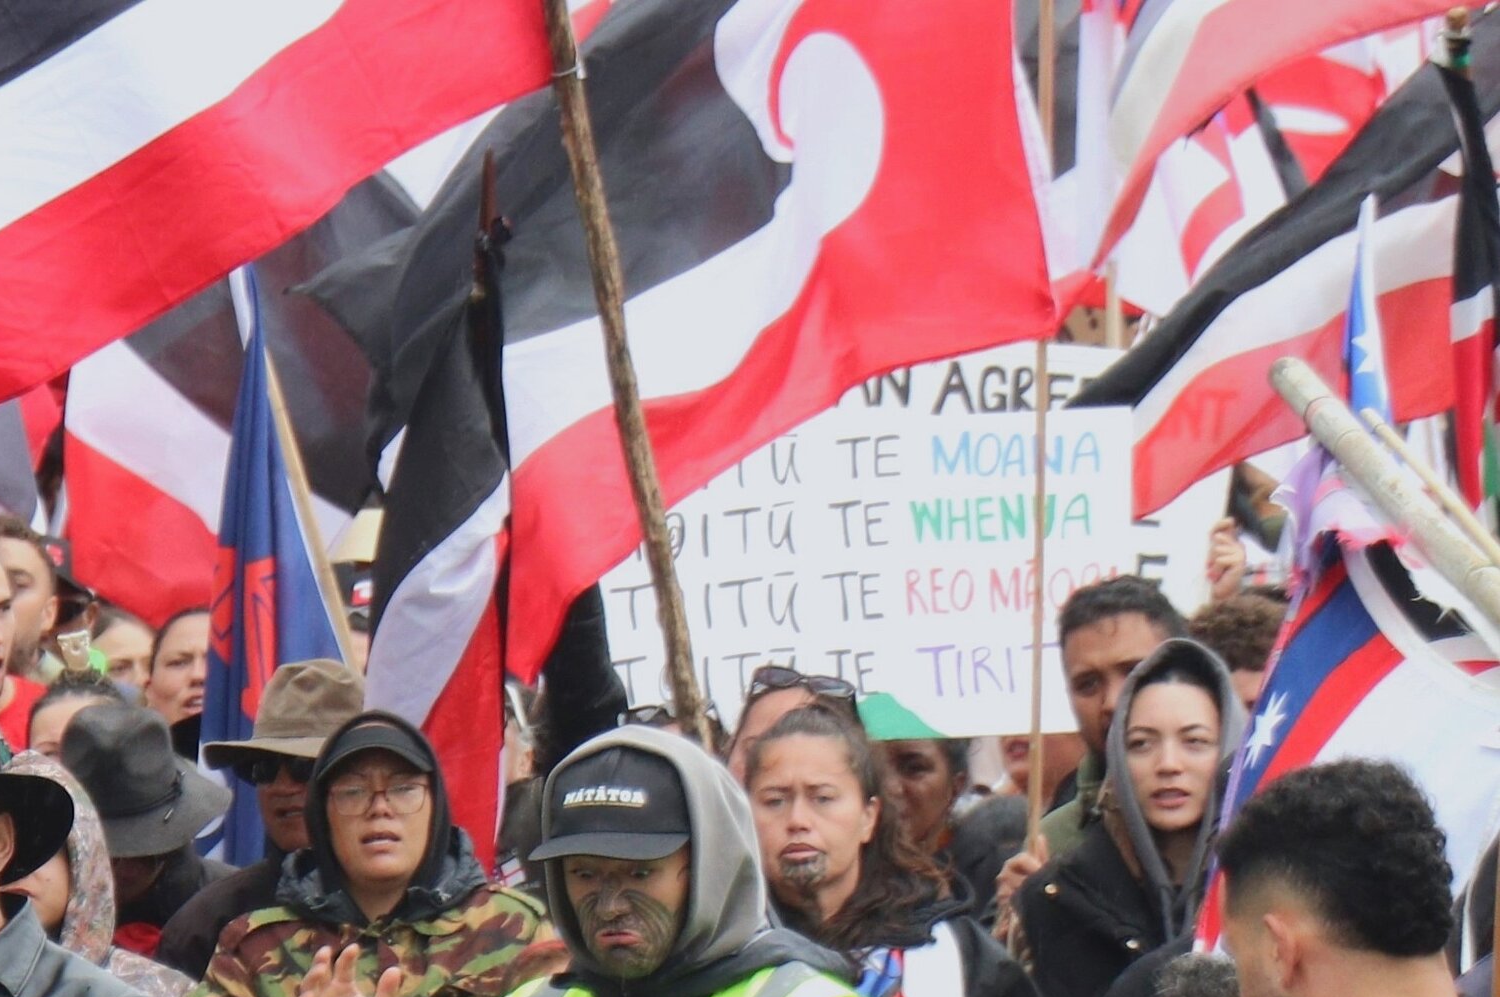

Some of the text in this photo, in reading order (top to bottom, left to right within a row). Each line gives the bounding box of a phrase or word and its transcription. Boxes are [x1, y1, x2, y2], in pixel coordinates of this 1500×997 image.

[836, 435, 901, 479] TE
[931, 431, 1100, 477] MOANA
[828, 501, 891, 549] TE
[610, 571, 801, 633] TITŪ
[822, 571, 885, 622] TE
[904, 568, 976, 616] REO
